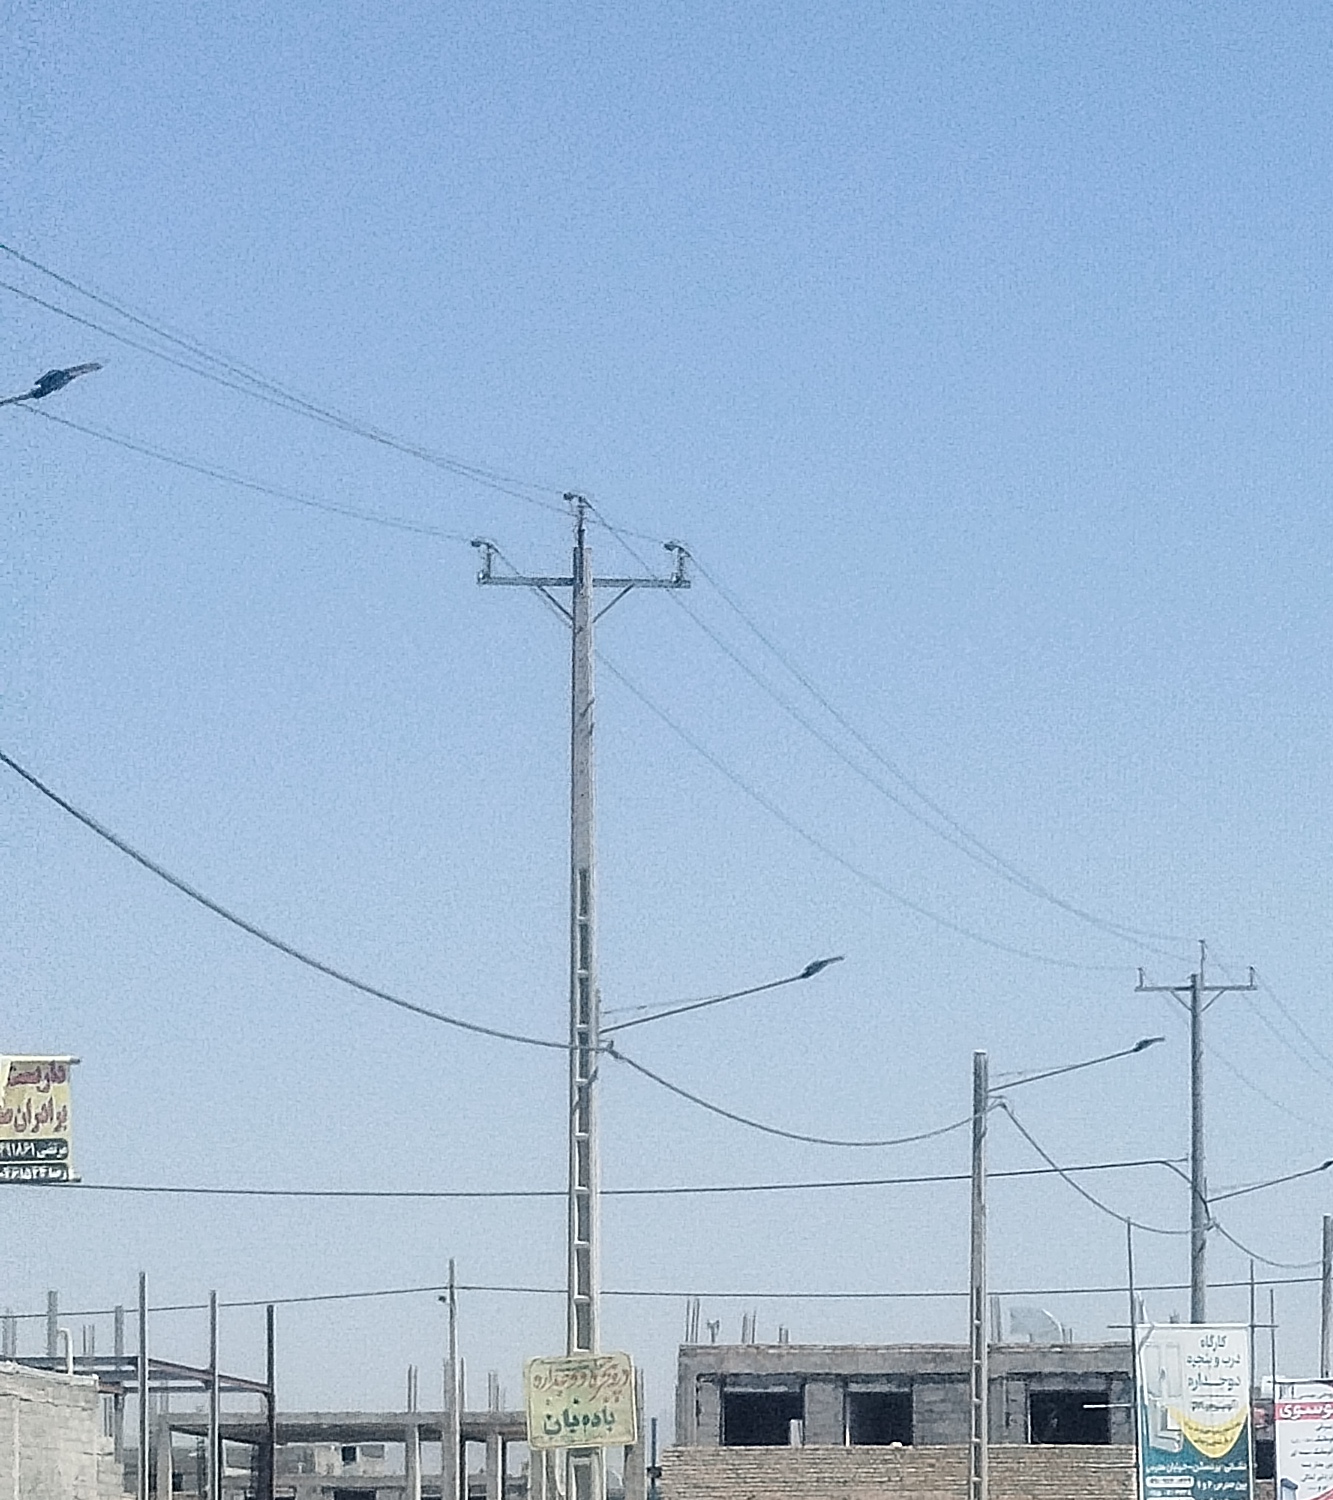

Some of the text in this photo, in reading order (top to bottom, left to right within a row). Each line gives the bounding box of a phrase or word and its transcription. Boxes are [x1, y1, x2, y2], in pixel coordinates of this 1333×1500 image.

[1200, 1334, 1227, 1352] کارگاه
[1186, 1353, 1241, 1369] درب و پنجره
[1187, 1372, 1241, 1391] دوجداره
